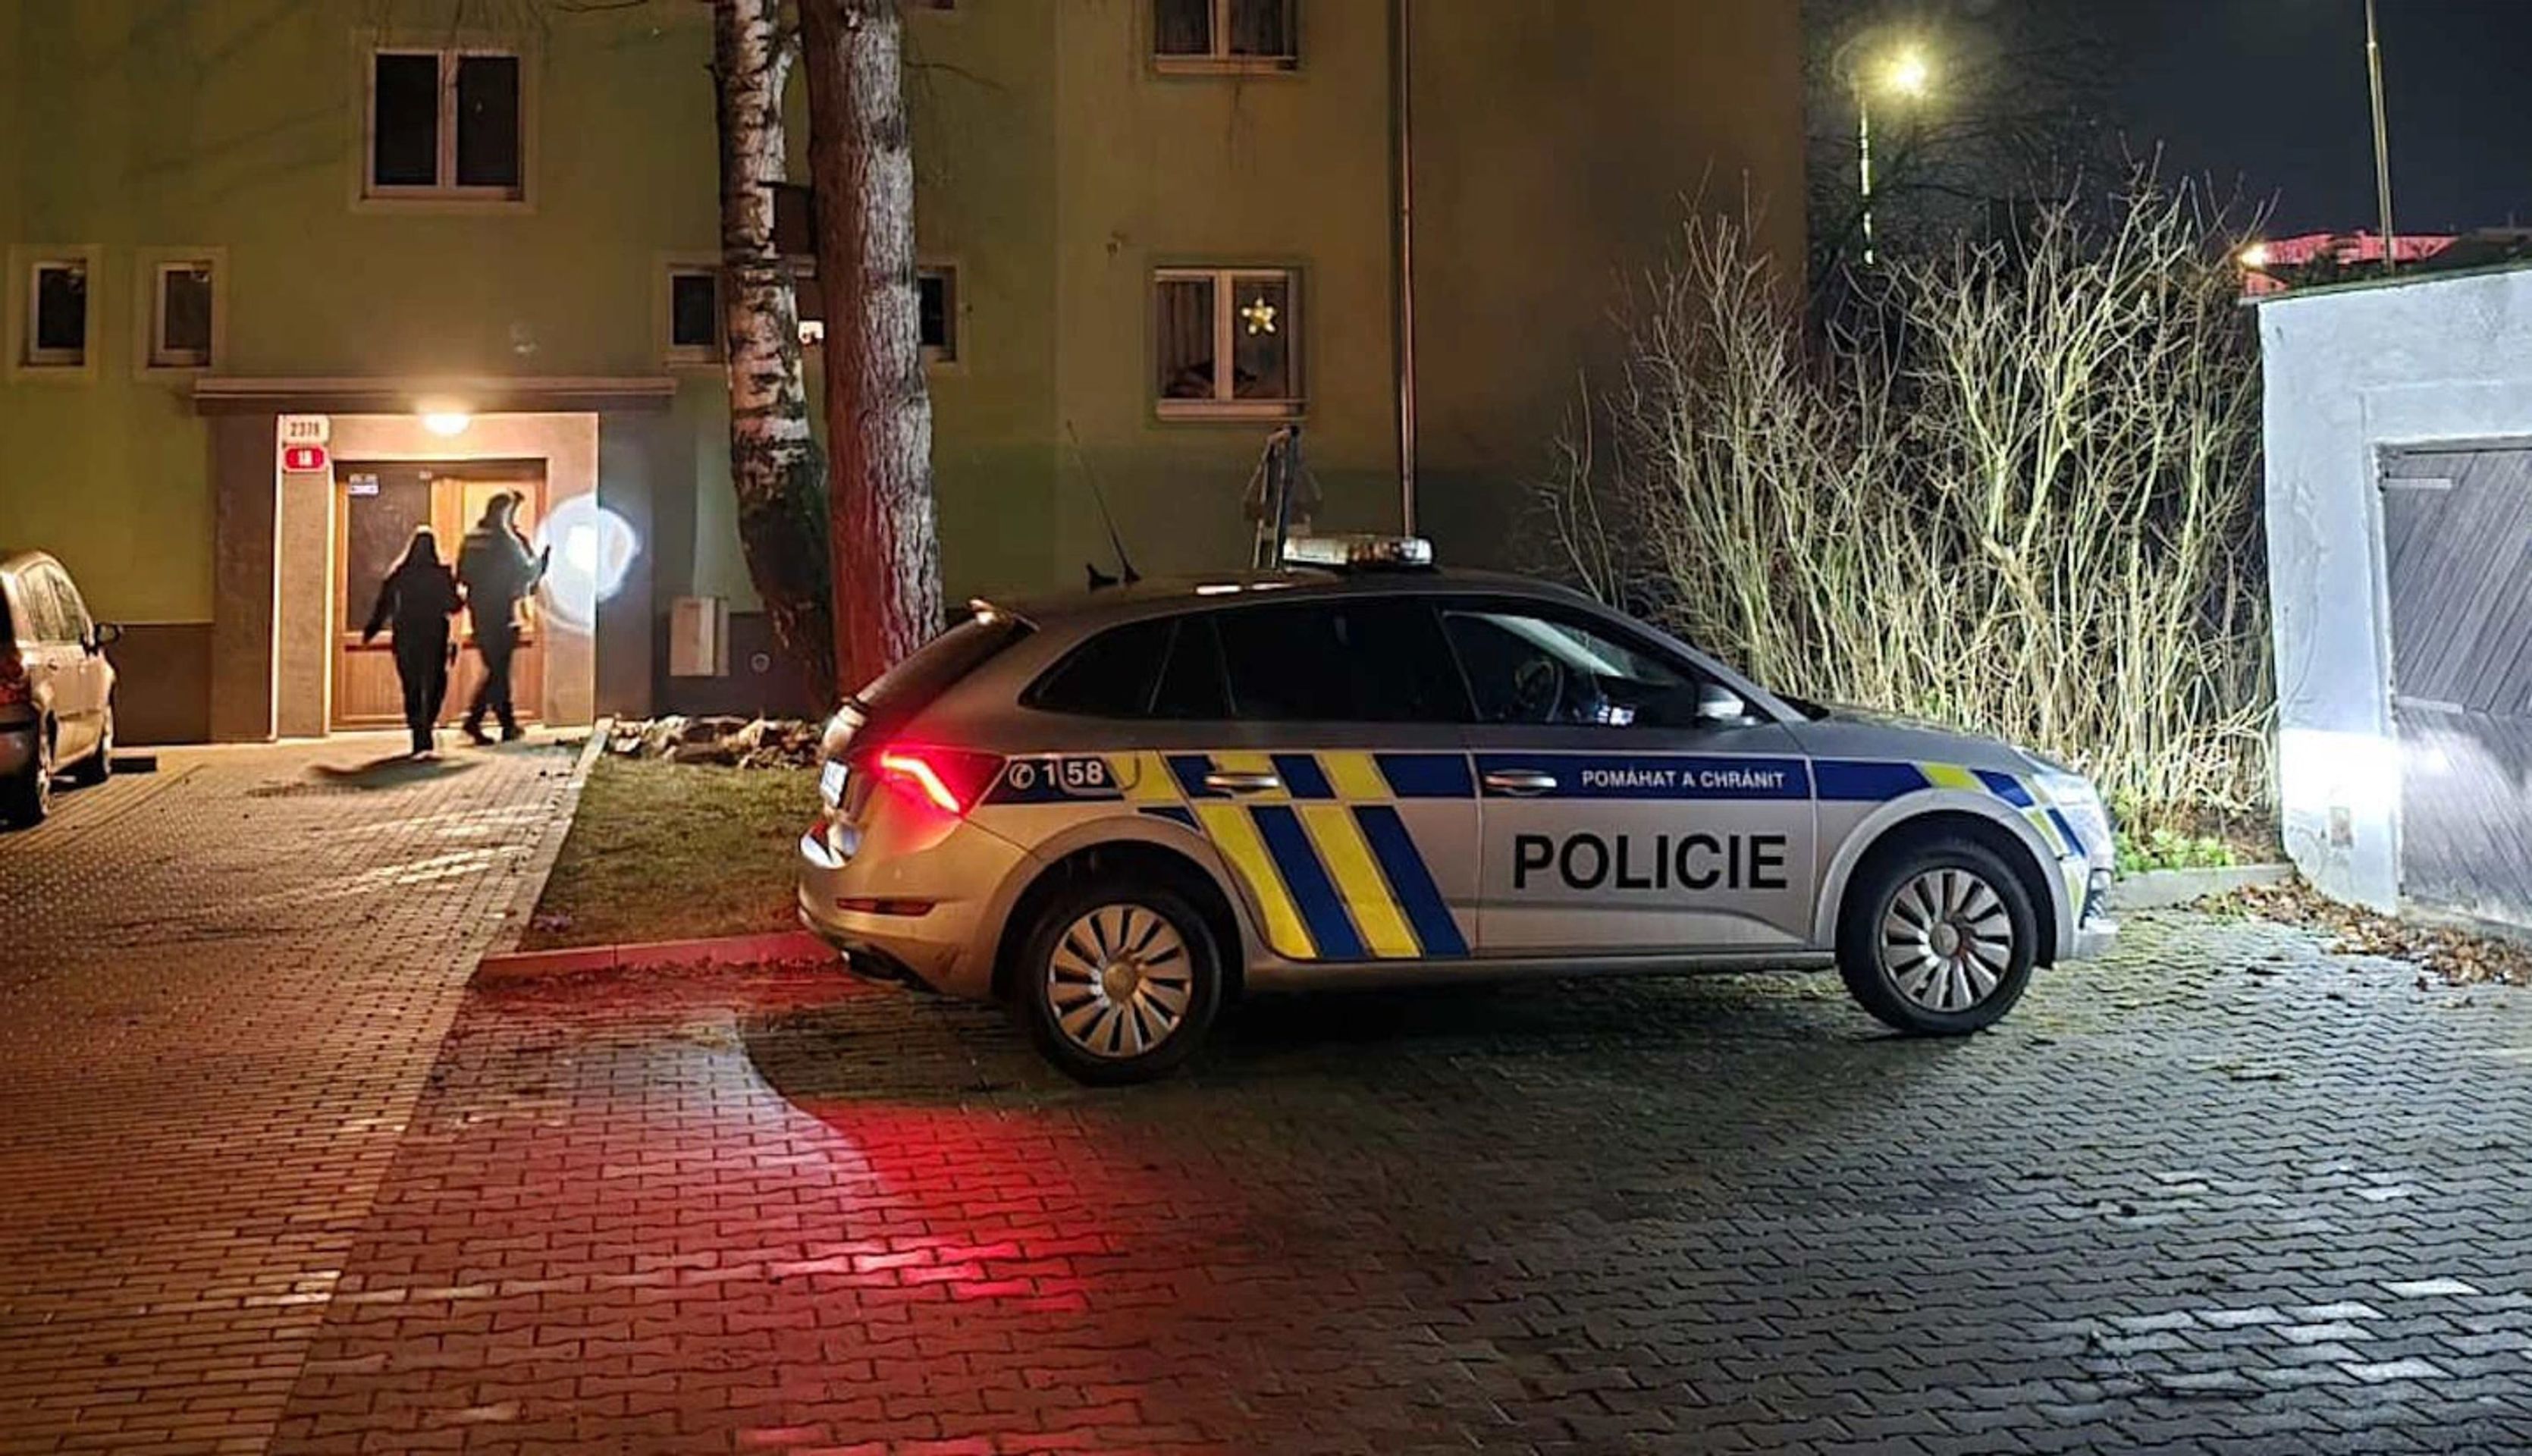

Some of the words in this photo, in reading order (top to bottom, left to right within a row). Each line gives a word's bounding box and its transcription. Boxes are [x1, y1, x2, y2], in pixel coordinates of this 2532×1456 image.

[1043, 761, 1105, 786] 158
[1582, 766, 1676, 788] POMÁHAT
[1682, 770, 1696, 788] A
[1700, 766, 1785, 789] CHRÁNIT
[1513, 833, 1788, 890] POLICIE
